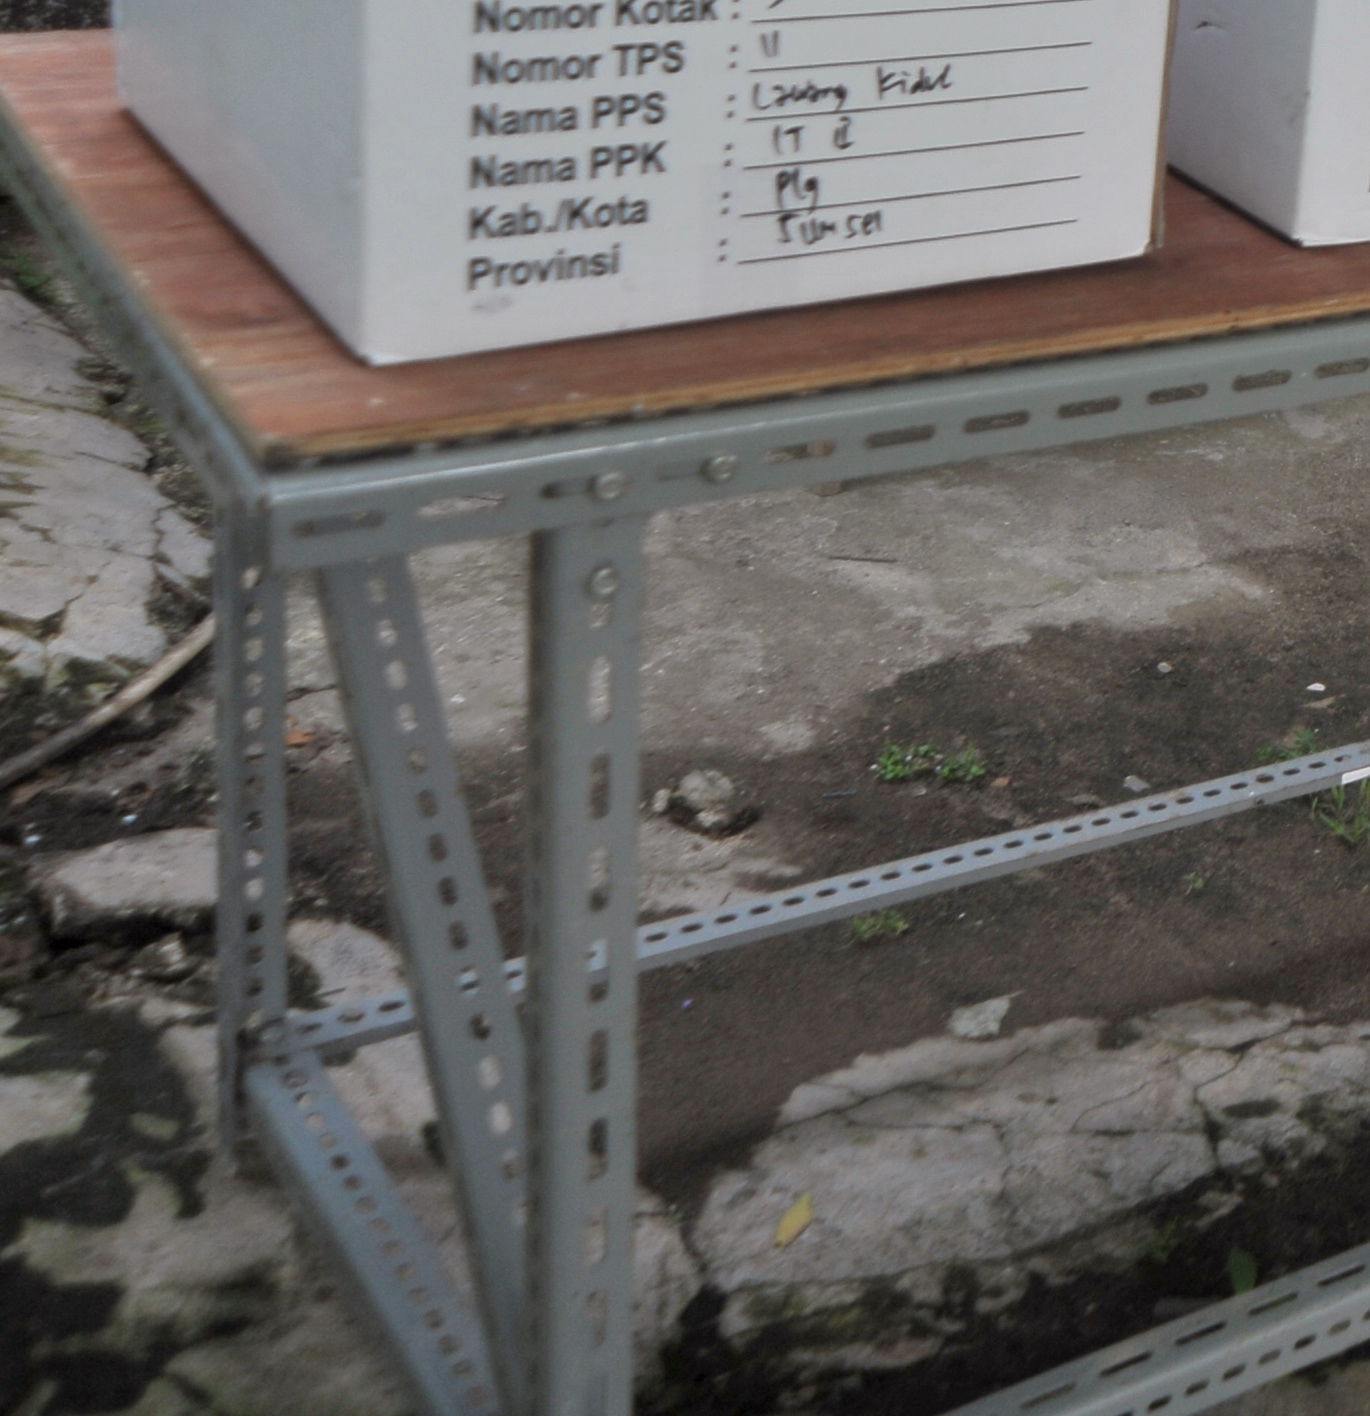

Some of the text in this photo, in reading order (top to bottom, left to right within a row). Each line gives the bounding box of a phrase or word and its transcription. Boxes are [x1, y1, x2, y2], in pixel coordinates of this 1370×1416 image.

[472, 40, 685, 84] Nomor TPS
[471, 91, 667, 137] Nama PPS
[469, 140, 668, 188] Nama PPK
[468, 195, 648, 240] Kab./Kota
[467, 241, 622, 291] Provinsi
